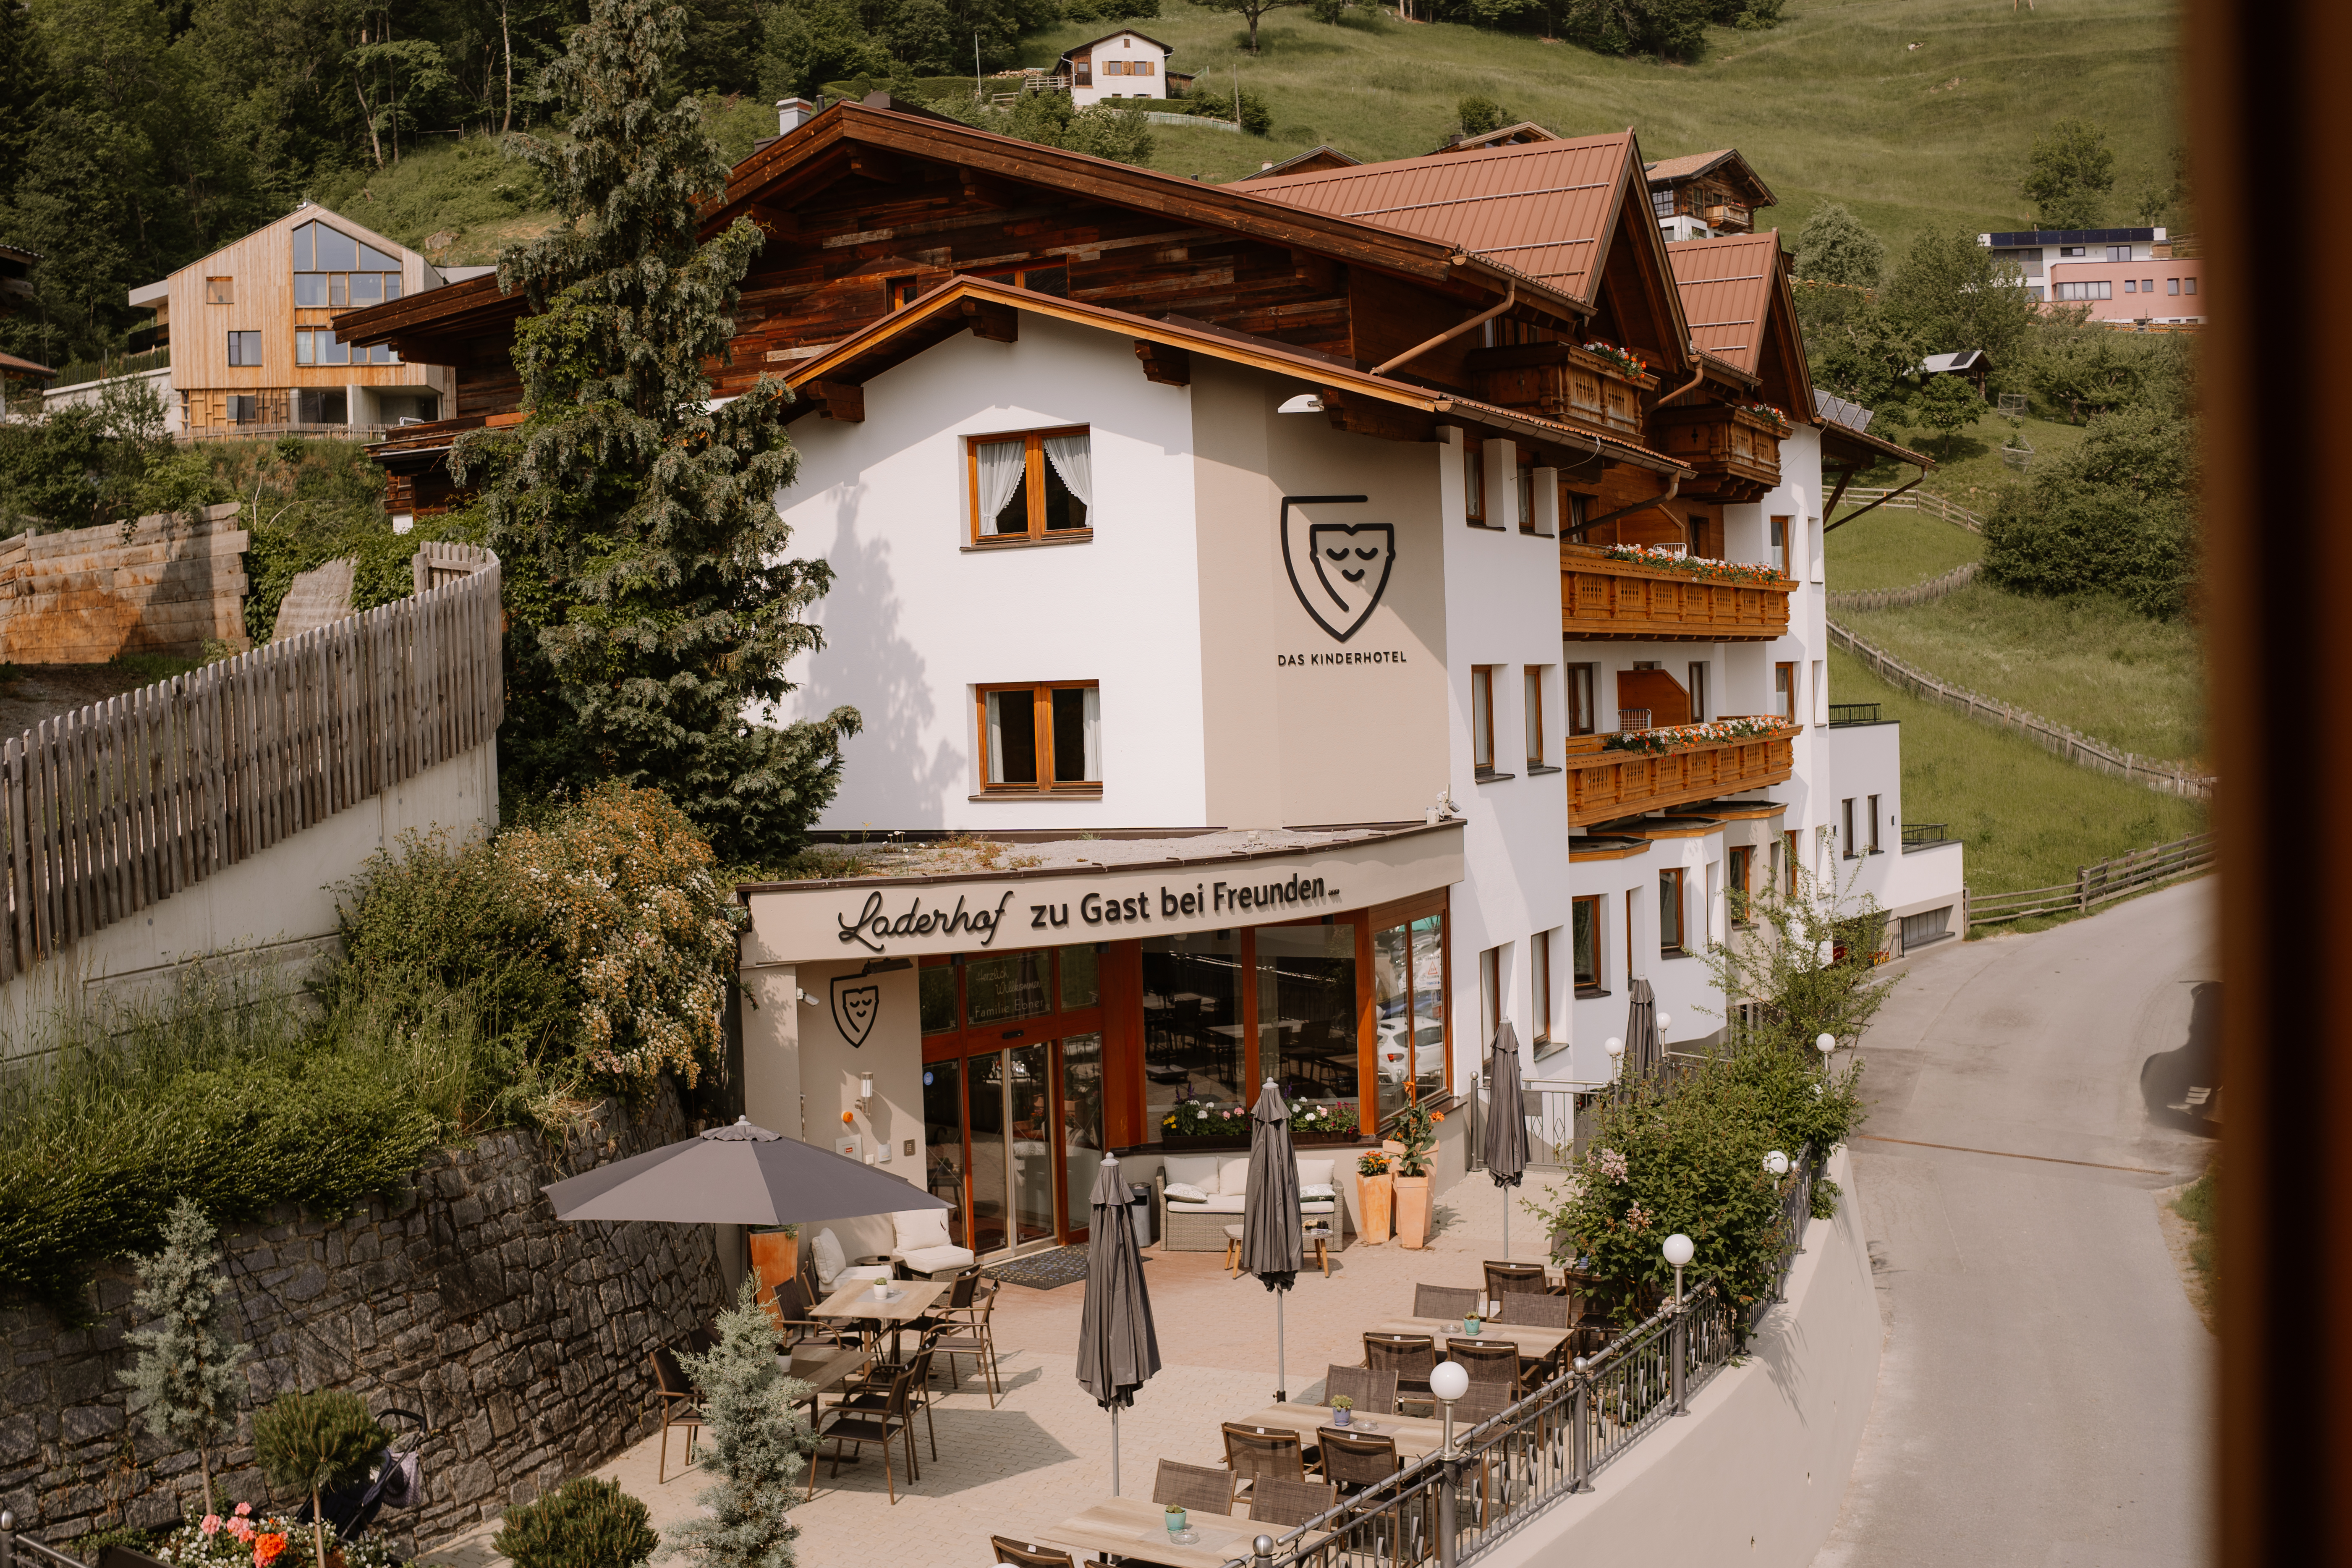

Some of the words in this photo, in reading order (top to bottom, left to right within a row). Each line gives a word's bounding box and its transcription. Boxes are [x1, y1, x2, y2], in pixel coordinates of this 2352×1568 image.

[1278, 654, 1305, 666] DAS
[1311, 651, 1407, 665] KINDERHOTEL
[838, 890, 1014, 952] Laderhof
[1030, 903, 1068, 927] zu
[1081, 892, 1150, 922] Gast
[1161, 882, 1203, 916] bei
[976, 966, 1009, 983] Herzlich
[995, 978, 1041, 995] Willkommen
[975, 1002, 1010, 1018] Familie
[1015, 998, 1044, 1011] Ebner
